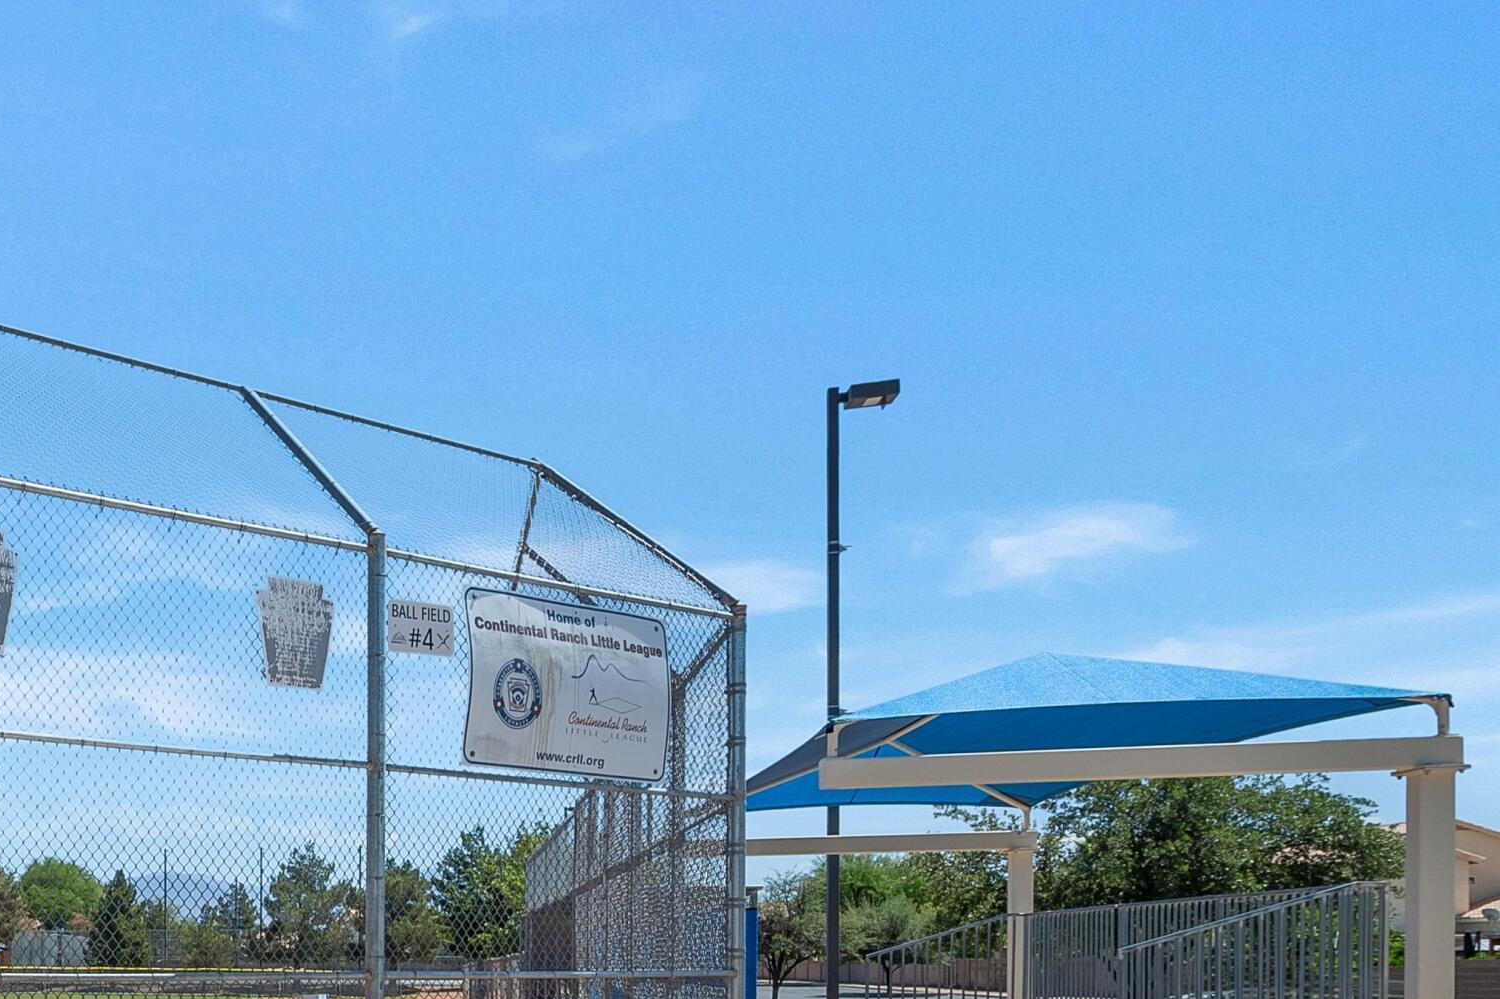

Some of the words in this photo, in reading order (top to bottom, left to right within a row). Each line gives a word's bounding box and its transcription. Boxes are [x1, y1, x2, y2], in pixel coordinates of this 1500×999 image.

[392, 604, 418, 620] BALL
[421, 607, 451, 623] FIELD
[547, 609, 581, 626] Home
[585, 616, 596, 628] of
[409, 628, 434, 650] #4
[474, 616, 547, 639] Continental
[551, 628, 588, 646] Ranch
[591, 634, 621, 650] Little
[623, 640, 663, 658] League
[568, 710, 620, 730] Continental
[621, 717, 648, 733] Ranch
[536, 751, 605, 769] www.crll.org
